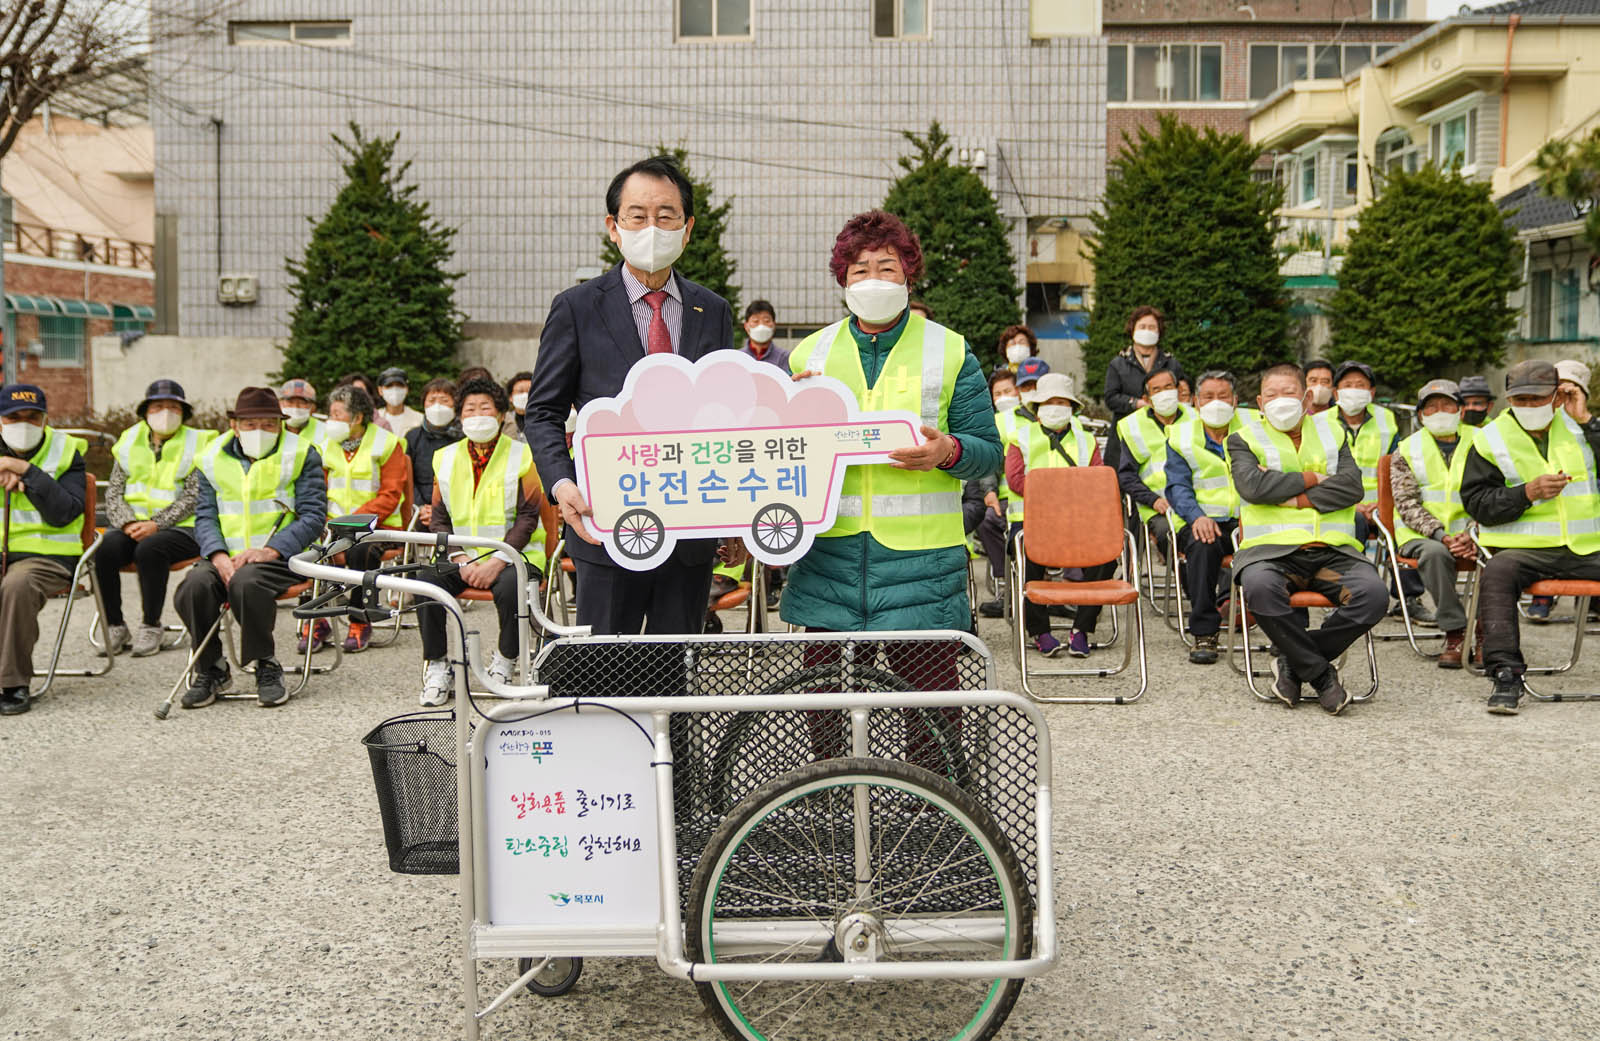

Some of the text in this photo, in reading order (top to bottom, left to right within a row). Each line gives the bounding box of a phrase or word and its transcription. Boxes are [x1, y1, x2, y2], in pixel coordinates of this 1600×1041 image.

[617, 437, 807, 467] 사랑과 건강을 위한
[862, 428, 881, 449] 목포
[618, 465, 807, 507] 안전손수레
[531, 741, 554, 765] 목포
[511, 789, 636, 820] 일회용품 줄이기로
[505, 834, 642, 861] 탄소중립 실천해요
[574, 894, 604, 905] 목포시
